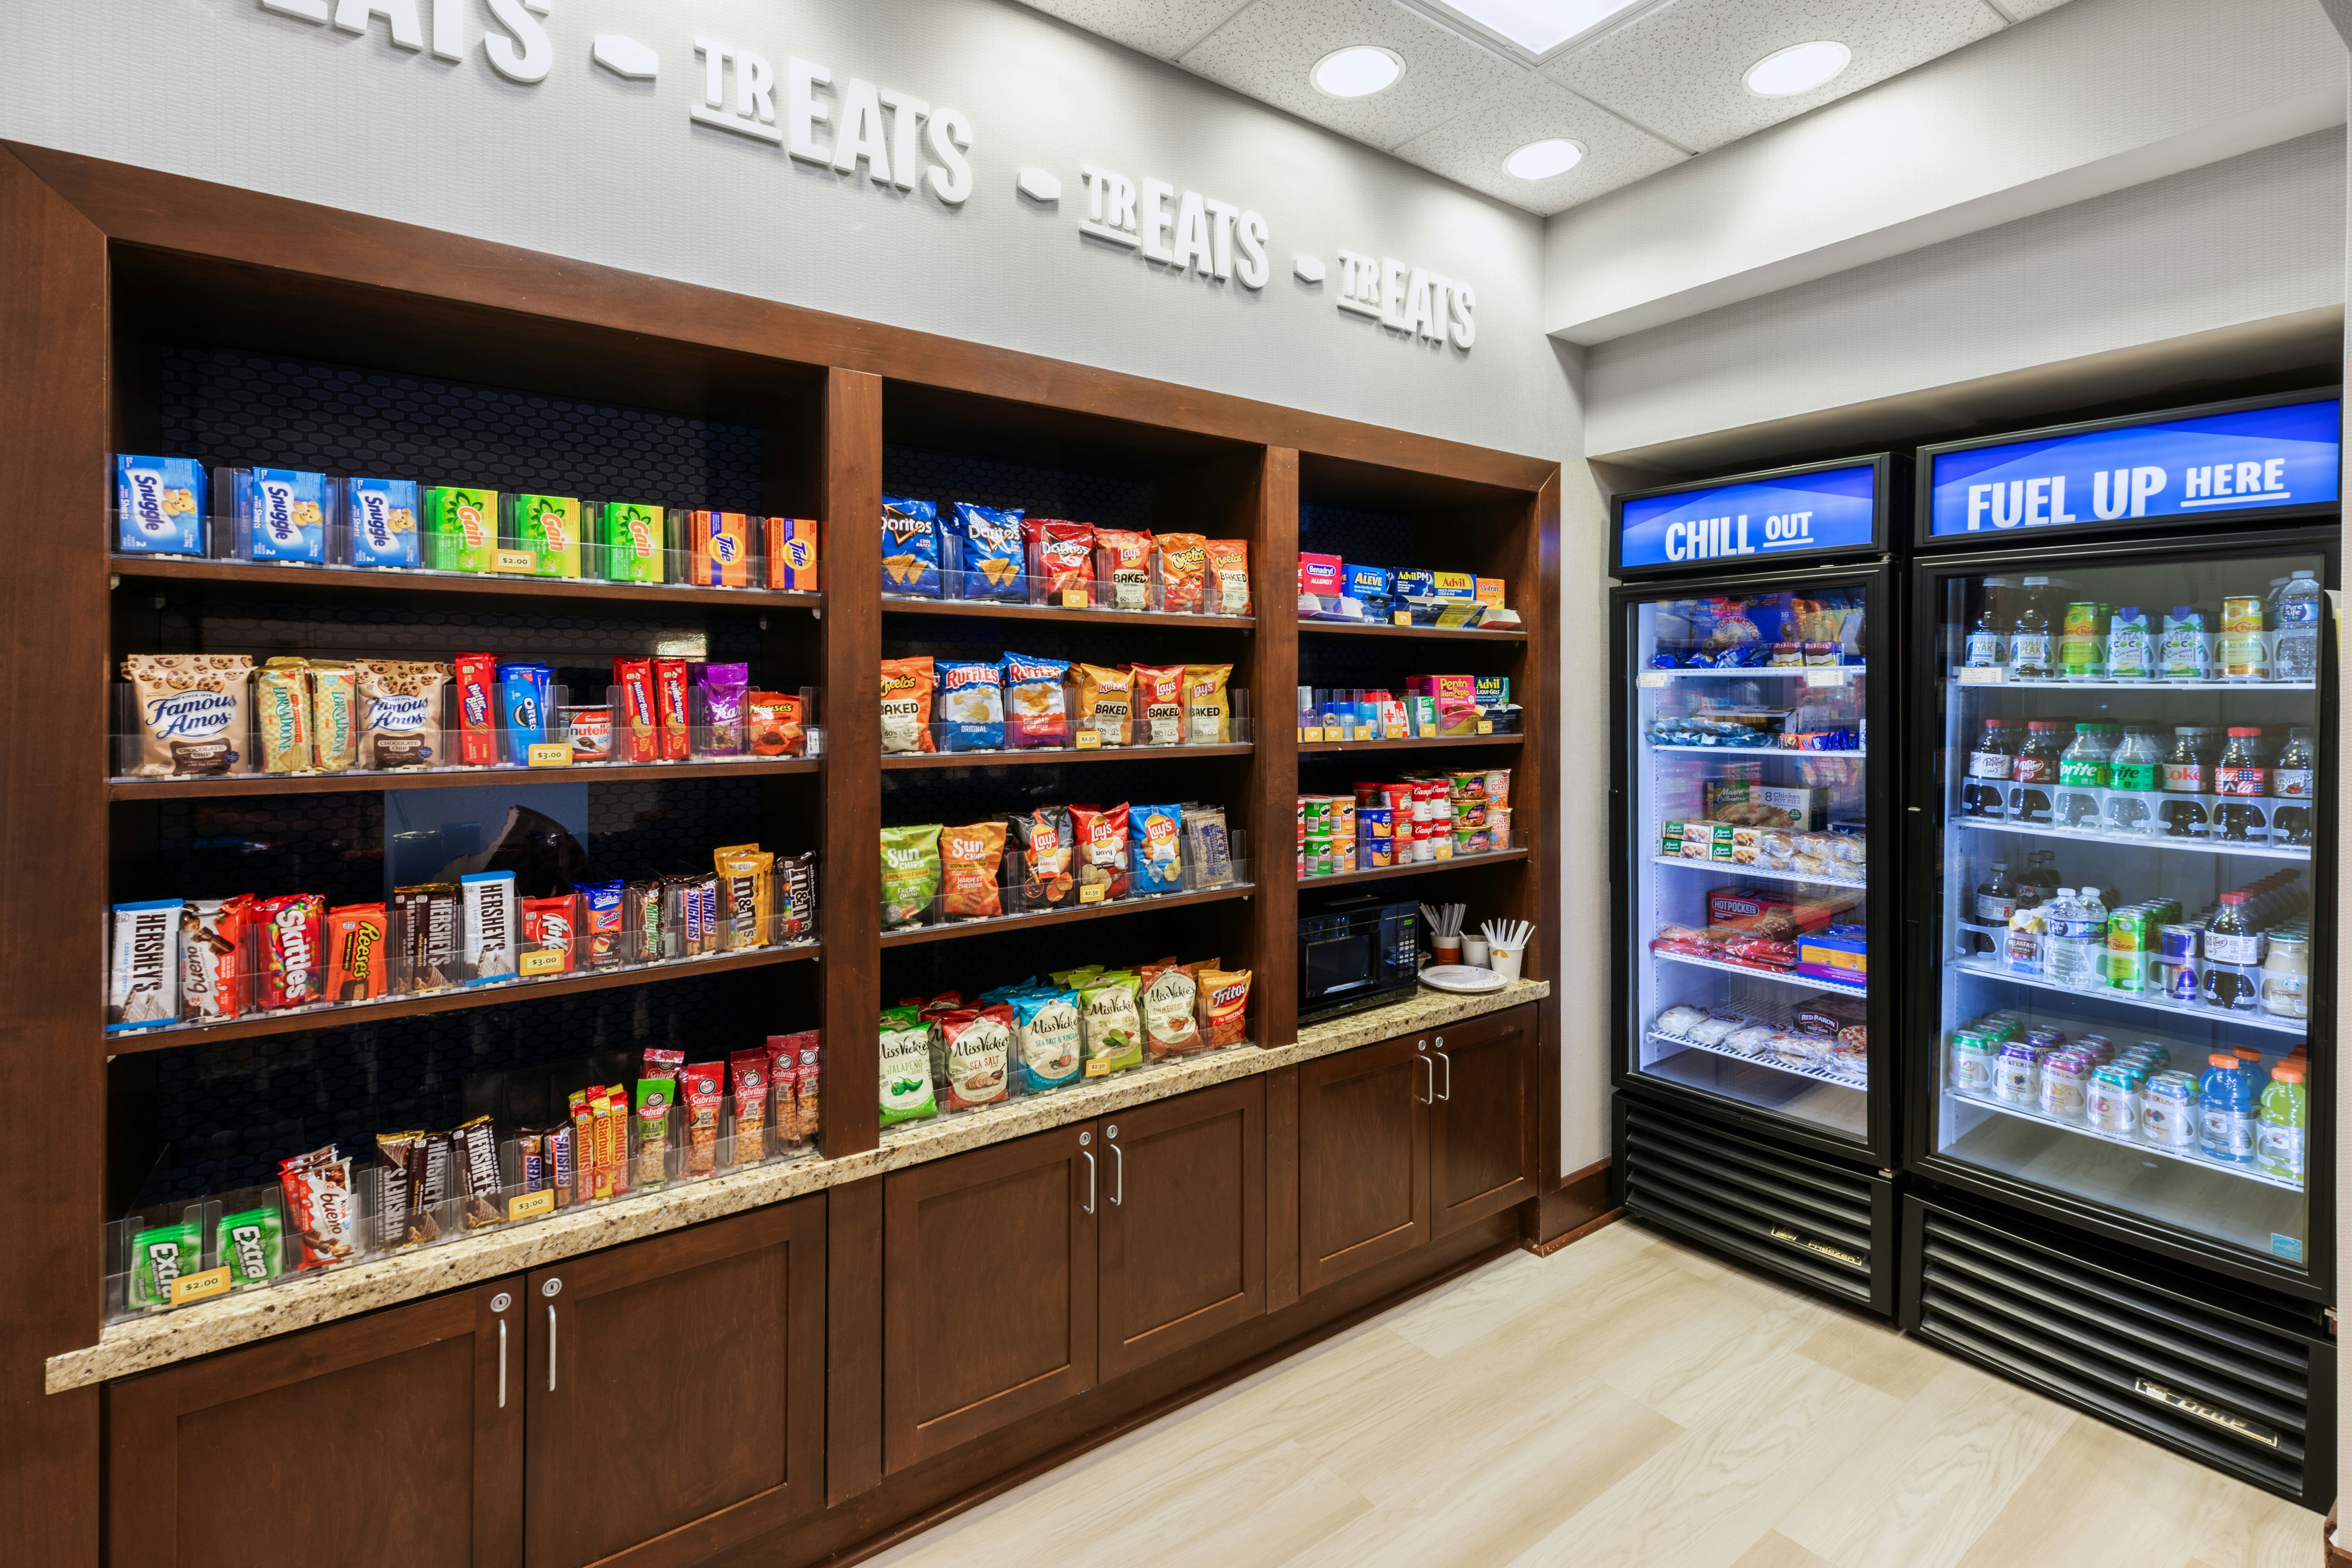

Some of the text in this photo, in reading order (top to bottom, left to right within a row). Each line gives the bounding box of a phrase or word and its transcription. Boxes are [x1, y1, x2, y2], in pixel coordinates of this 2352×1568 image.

[693, 36, 974, 204] TREATS
[1080, 165, 1270, 289] TREATS
[1338, 250, 1476, 349] TREATS
[134, 475, 166, 531] Snuggle
[1967, 458, 2286, 531] FUEL UP HERE
[121, 498, 130, 520] Sheets
[254, 509, 262, 529] Sheets
[268, 486, 294, 540] Snuggle
[364, 495, 391, 547] Snuggle
[457, 505, 482, 547] Gain
[540, 512, 564, 551] Gain
[629, 520, 651, 558] Gain
[1665, 511, 1813, 561] CHILL OUT
[714, 534, 736, 562] Tide
[787, 540, 808, 568] Tide
[1120, 548, 1140, 561] Lay's
[1215, 552, 1243, 568] Cheetos
[1309, 565, 1334, 575] Benadryl
[1113, 574, 1146, 583] BAKED
[1220, 572, 1247, 582] BAKED
[1354, 572, 1382, 587] ALEVE
[1397, 571, 1429, 581] Advil PM
[1442, 577, 1466, 587] Advil
[1479, 584, 1499, 593] Motrin
[1974, 636, 1994, 644] GOLD
[2020, 637, 2042, 645] GOLD
[2116, 632, 2140, 641] VITA
[2167, 631, 2192, 641] VITA
[2020, 645, 2042, 654] PEAK
[946, 666, 999, 688] RUFFLES
[1475, 678, 1501, 689] Advil
[468, 683, 487, 709] Nutter
[1156, 681, 1176, 697] Lay's
[1454, 687, 1469, 696] Pepto
[145, 695, 237, 727] Famous
[364, 697, 429, 720] Famous
[465, 696, 484, 721] Butter
[523, 697, 537, 731] OREO
[1095, 705, 1128, 716] BAKED
[1148, 707, 1180, 717] BAKED
[1192, 707, 1220, 717] BAKED
[156, 712, 232, 740] Amos
[367, 712, 426, 731] Amos
[1985, 759, 2005, 768] Pepper
[2020, 761, 2042, 771] Pepper
[2060, 762, 2097, 777] Sprite
[2163, 765, 2203, 781] Coke
[1720, 788, 1745, 797] Marie
[1765, 791, 1773, 802] 8
[1033, 829, 1057, 851] Lay's
[1091, 821, 1113, 842] Lay's
[1147, 820, 1173, 840] Lay's
[887, 848, 919, 868] Sun
[951, 838, 984, 858] Sun
[900, 860, 925, 870] CHIPS
[687, 891, 700, 940] SNICKERS
[702, 885, 716, 935] SNICKERS
[1714, 899, 1757, 915] HOT POCKETS
[480, 883, 505, 953] HERSHEY'S
[598, 912, 620, 927] Gansito
[428, 898, 453, 966] HERSHEY'S
[133, 914, 167, 993] HERSHEY'S
[275, 909, 312, 999] Skittles
[352, 920, 382, 979] Reese's
[187, 946, 208, 994] bueno
[532, 957, 557, 966] $3.00
[1149, 982, 1196, 1004] Miss Vickie's
[1212, 982, 1246, 1008] Fritos
[1090, 1002, 1112, 1016] Miss
[1152, 1002, 1185, 1016] SMOKEHOUSE
[1225, 1007, 1245, 1021] ORIGINAL
[1030, 1019, 1055, 1035] Miss
[1801, 1013, 1836, 1028] RED BARON
[953, 1032, 1009, 1058] Miss Vickie's
[887, 1059, 923, 1075] JALAPEÑO
[970, 1055, 1000, 1071] SEA SALT
[772, 1071, 797, 1079] Sabritas
[691, 1095, 722, 1106] Sabritas
[738, 1087, 767, 1098] Sabritas
[578, 1122, 593, 1172] Starburst
[597, 1118, 611, 1168] Starburst
[467, 1128, 497, 1198] HERSHEY'S
[319, 1193, 342, 1235] bueno
[384, 1168, 408, 1241] HERSHEY'S
[519, 1198, 544, 1210] $3.00
[230, 1225, 268, 1279] Extra
[1808, 1242, 1855, 1262] FREEZER
[148, 1242, 180, 1299] Extra
[186, 1278, 218, 1291] $2.00
